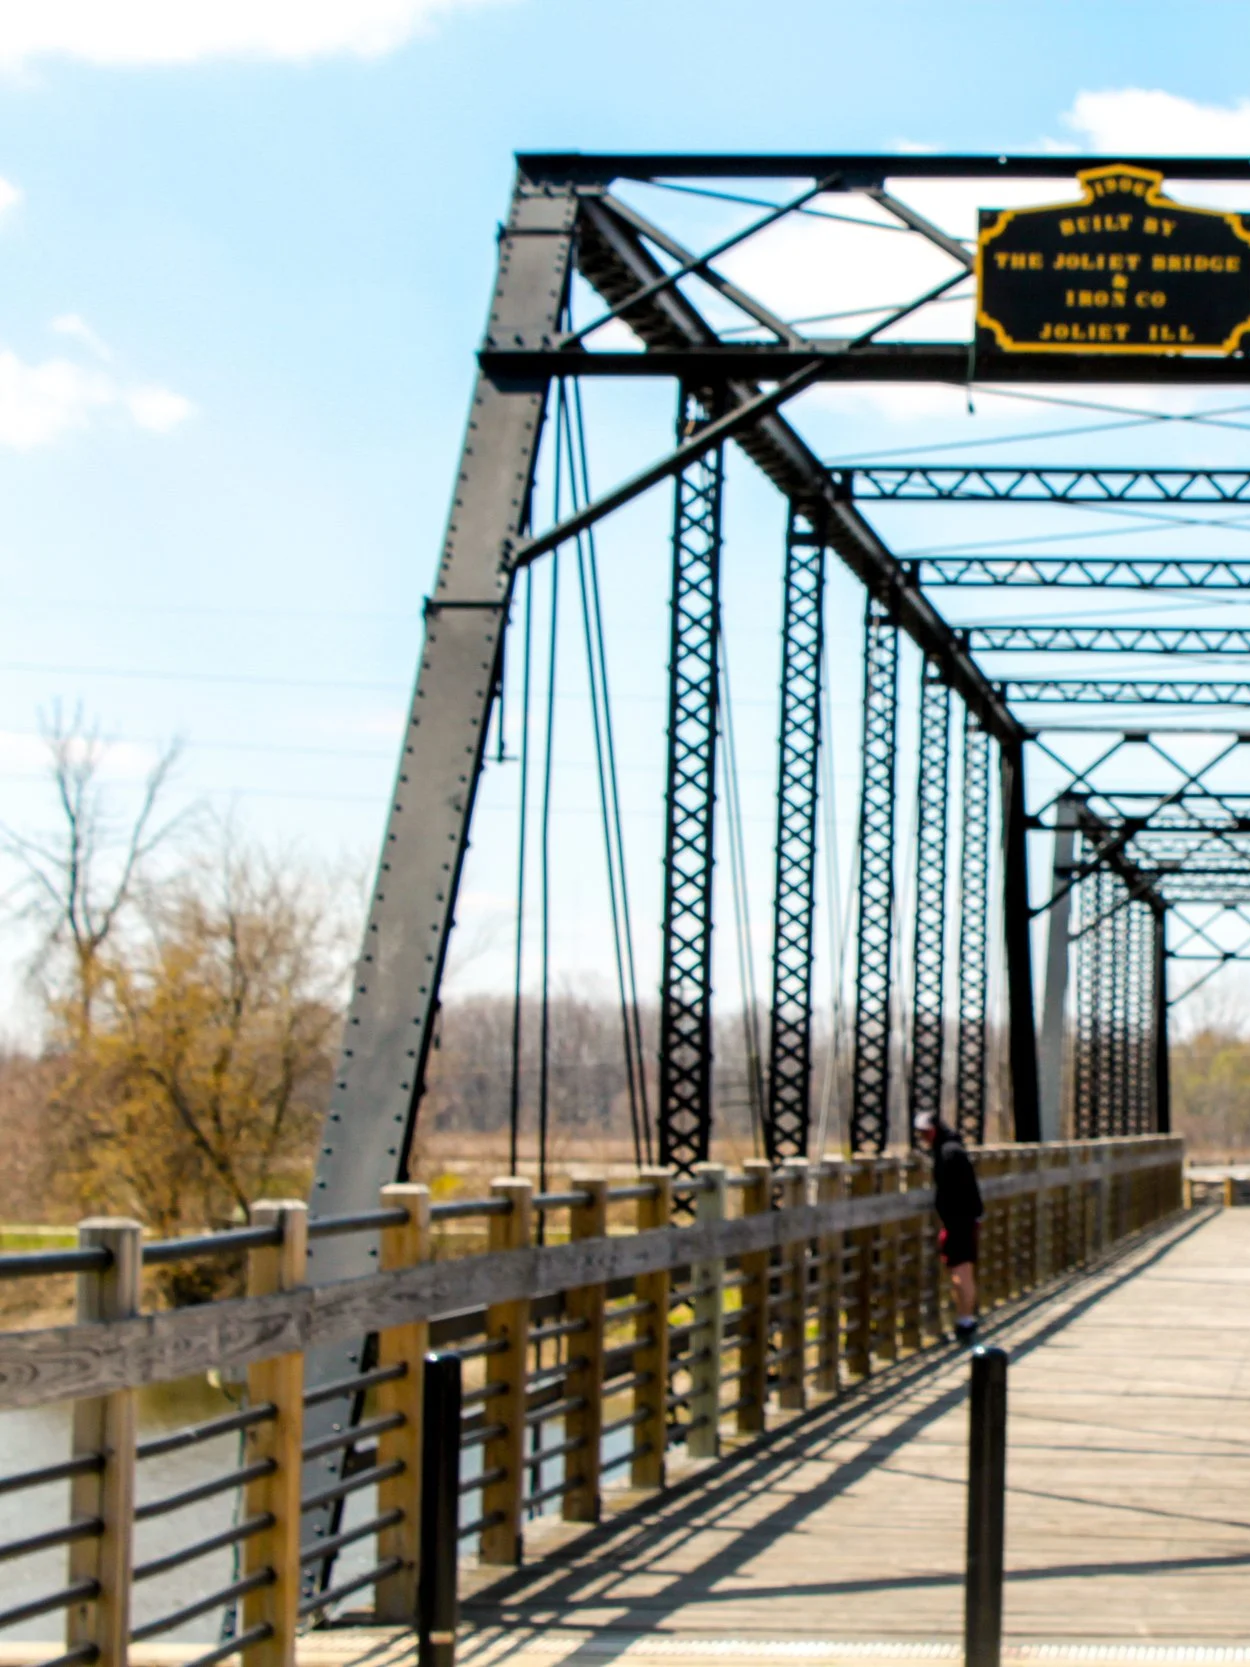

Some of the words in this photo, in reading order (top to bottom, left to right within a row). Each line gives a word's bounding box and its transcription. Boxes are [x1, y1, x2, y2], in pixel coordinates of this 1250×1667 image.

[1059, 214, 1133, 236] BUILT
[1144, 216, 1176, 236] BY
[994, 252, 1043, 270] THE
[1052, 253, 1141, 271] JOLIET
[1152, 254, 1241, 272] BRIDGE
[1112, 274, 1129, 289] &
[1065, 290, 1126, 308] IRON
[1135, 291, 1167, 308] CO
[1039, 323, 1130, 341] JOLIET
[1150, 324, 1195, 342] ILL
